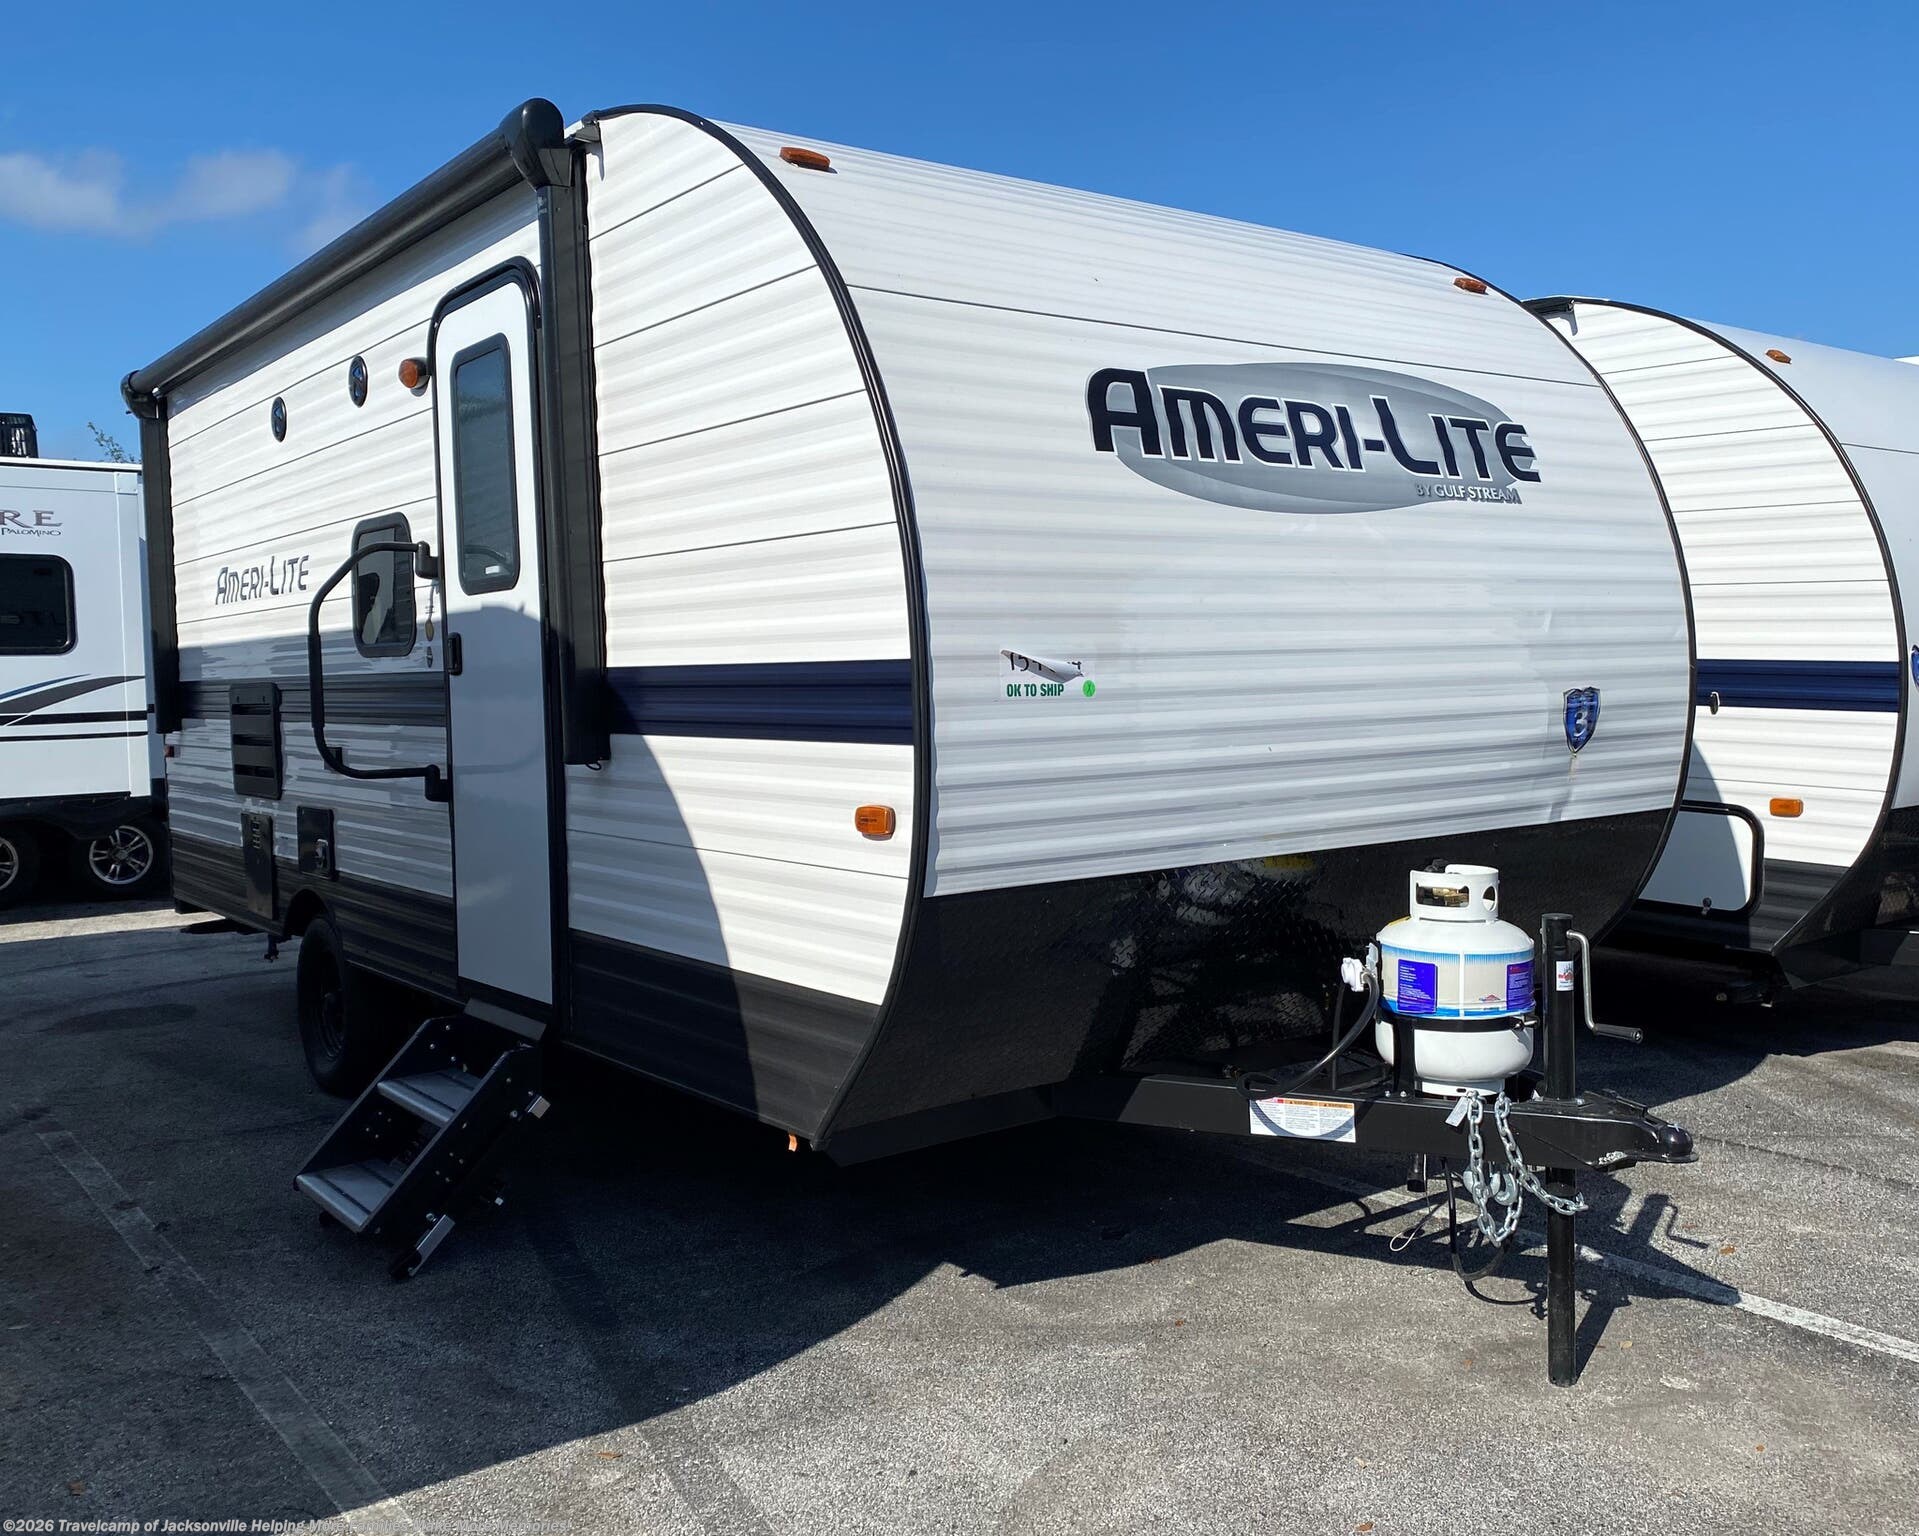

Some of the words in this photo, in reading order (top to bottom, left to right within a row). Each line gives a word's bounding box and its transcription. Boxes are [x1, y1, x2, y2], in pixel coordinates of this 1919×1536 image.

[1086, 366, 1542, 483] AMERI-LITE
[1435, 484, 1466, 500] GULF
[1467, 486, 1522, 505] STREAM
[215, 555, 310, 605] AMERI-LITE
[1006, 683, 1021, 698] OK
[1024, 683, 1037, 697] TO
[1040, 683, 1065, 697] SHIP
[1574, 710, 1588, 737] 3
